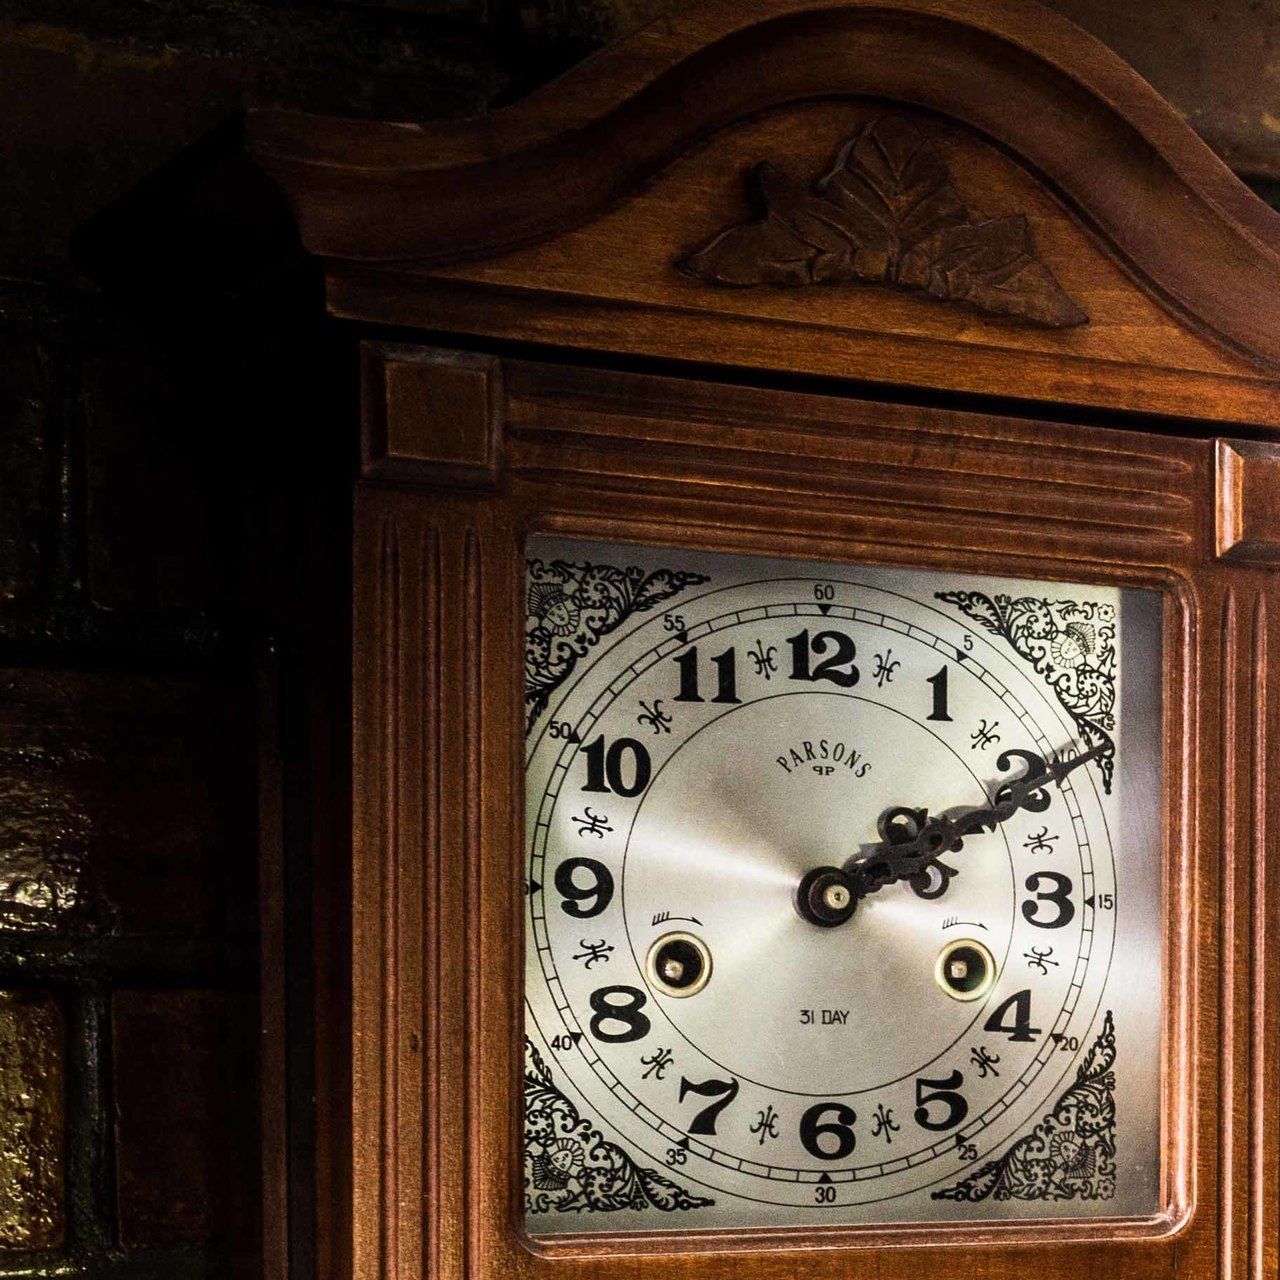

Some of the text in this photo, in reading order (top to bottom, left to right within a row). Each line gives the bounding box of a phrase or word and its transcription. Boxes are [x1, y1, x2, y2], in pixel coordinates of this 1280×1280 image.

[814, 584, 835, 602] 60
[663, 614, 687, 632] 55
[963, 635, 974, 651] 5
[671, 645, 743, 704] 11
[786, 629, 860, 687] 12
[926, 664, 954, 721] 1
[549, 722, 571, 741] 50
[579, 735, 651, 798] 10
[776, 739, 872, 778] PARSONS
[995, 749, 1051, 812] 2
[554, 857, 614, 918] 9
[1021, 871, 1075, 929] 3
[1098, 894, 1114, 910] 15
[590, 985, 651, 1043] 8
[800, 1009, 851, 1025] 31 DAY
[983, 990, 1042, 1042] 4
[551, 1035, 573, 1052] 40
[1060, 1036, 1079, 1052] 20
[679, 1076, 739, 1135] 7
[914, 1070, 968, 1131] 5
[799, 1102, 857, 1160] 6
[957, 1144, 978, 1161] 25
[665, 1149, 688, 1166] 35
[815, 1186, 836, 1204] 30
